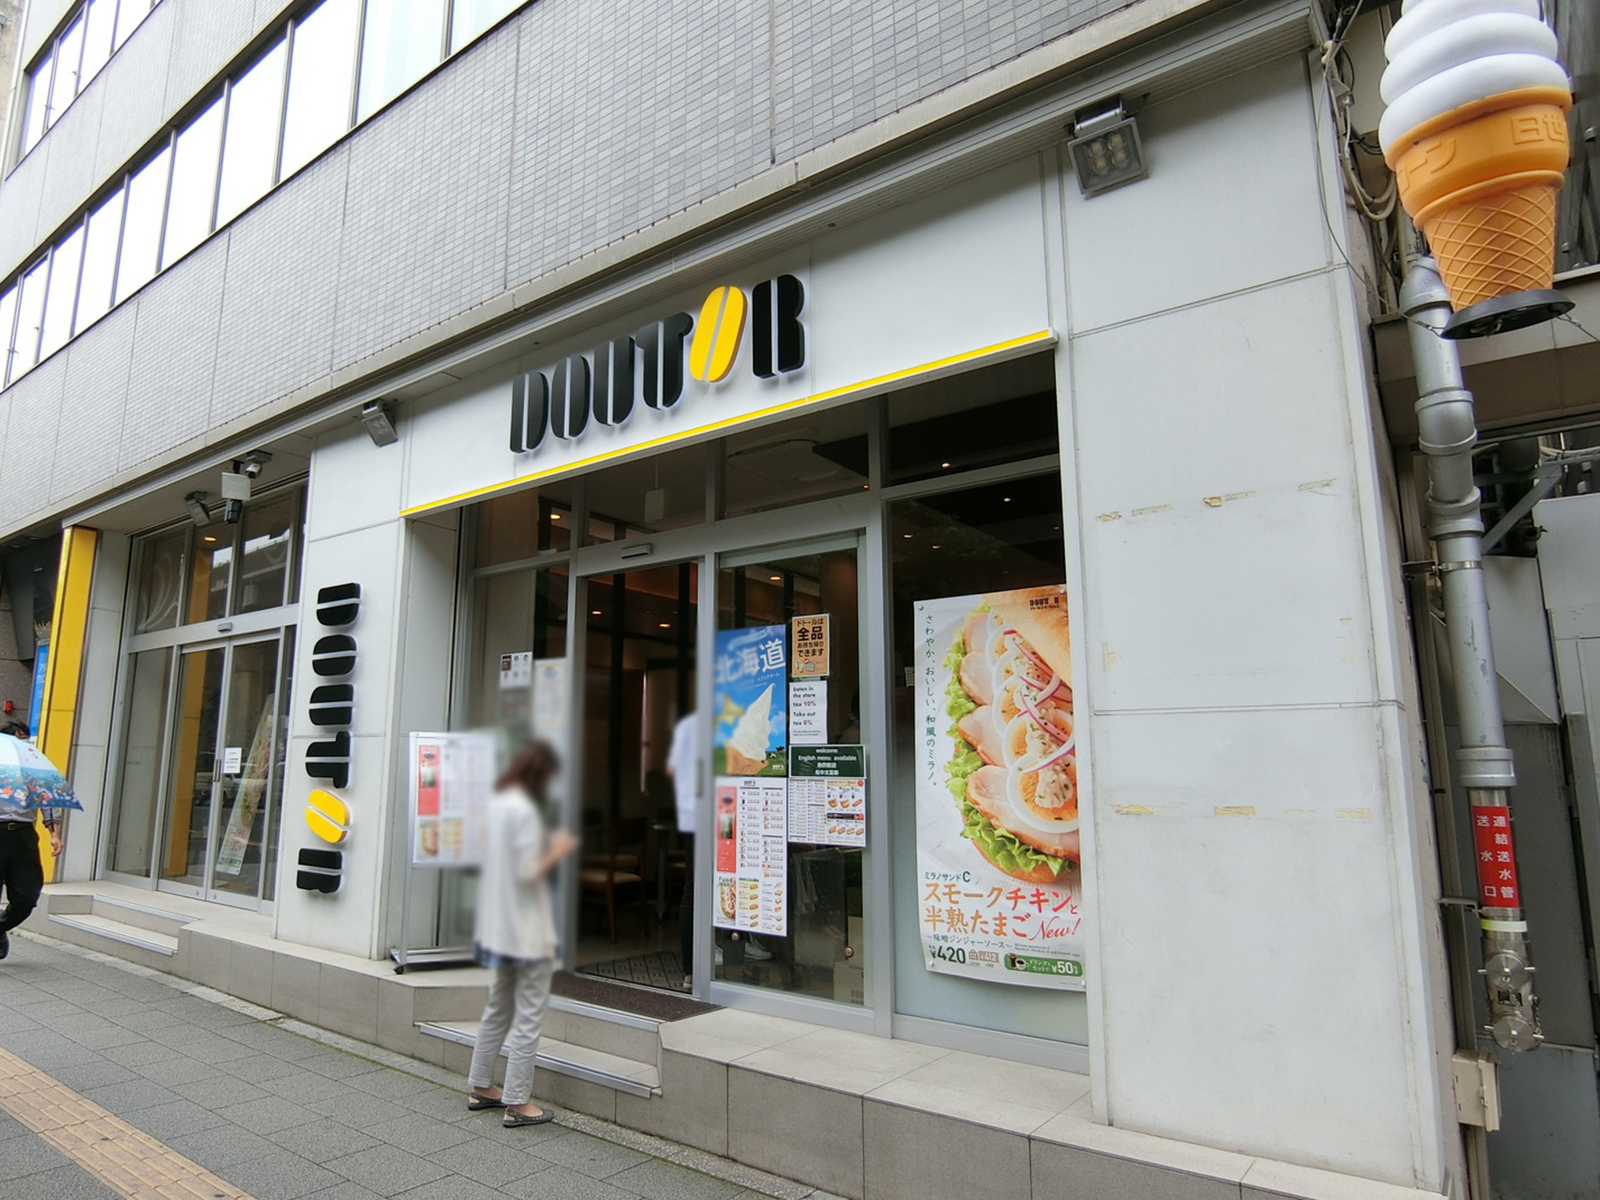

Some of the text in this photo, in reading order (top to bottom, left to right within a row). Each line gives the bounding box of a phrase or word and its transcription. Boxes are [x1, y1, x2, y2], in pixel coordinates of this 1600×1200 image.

[509, 274, 805, 454] DOUTOR
[797, 626, 823, 641] 全品
[797, 648, 824, 657] できます
[296, 582, 361, 895] DOUTOR
[1476, 815, 1497, 897] 送水口
[1492, 815, 1514, 899] 連結送水管
[924, 883, 1078, 915] スモークチキンと
[923, 905, 1032, 938] 半熟たまご
[1028, 916, 1082, 941] New!
[930, 945, 966, 964] ¥420
[1051, 960, 1074, 974] ¥50
